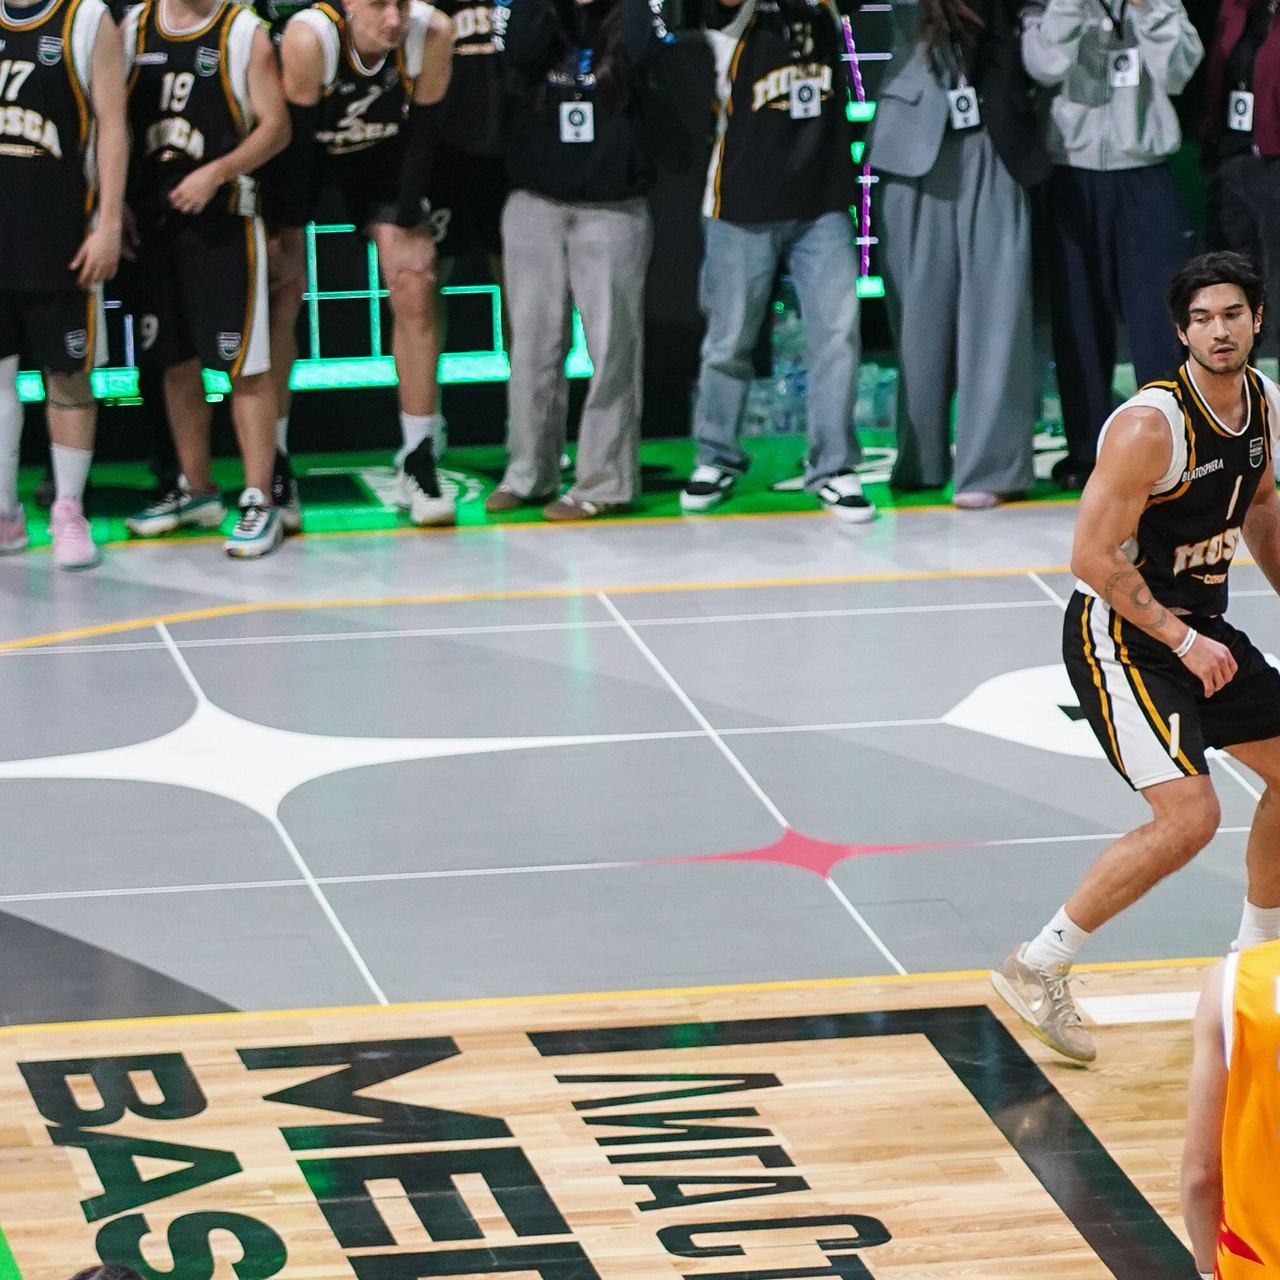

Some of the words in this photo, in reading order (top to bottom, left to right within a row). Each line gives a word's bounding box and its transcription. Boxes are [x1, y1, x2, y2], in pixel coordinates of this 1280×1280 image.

[160, 72, 195, 113] 19
[1181, 458, 1224, 483] BLATOSPHERA
[1226, 474, 1243, 521] 1
[1168, 711, 1181, 759] 1
